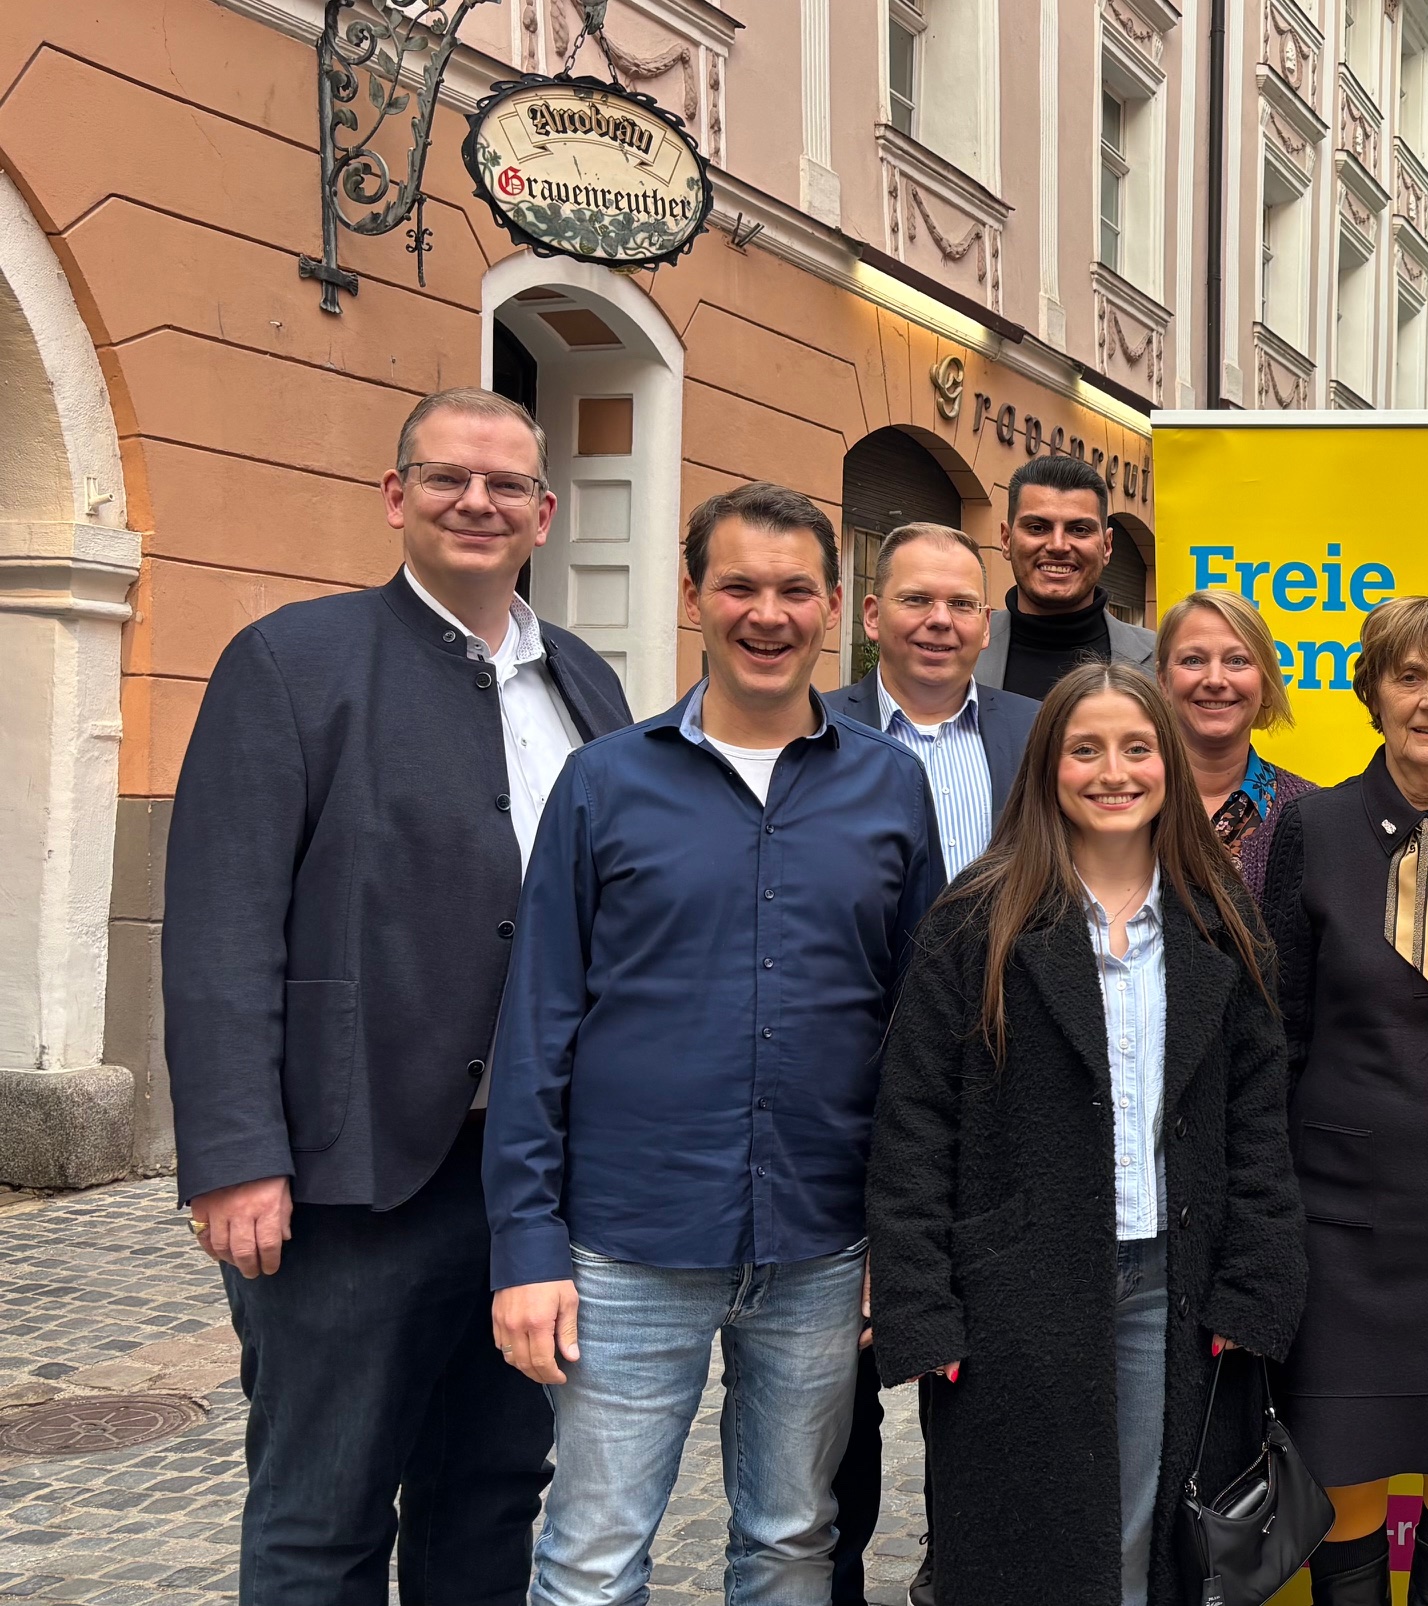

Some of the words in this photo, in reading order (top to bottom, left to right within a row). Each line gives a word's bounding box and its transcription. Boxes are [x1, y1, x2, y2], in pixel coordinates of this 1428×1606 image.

[528, 100, 654, 154] Arcobräu
[498, 165, 692, 221] Gravenreuther
[929, 354, 1151, 504] Gravenreut
[1189, 543, 1396, 613] Freie
